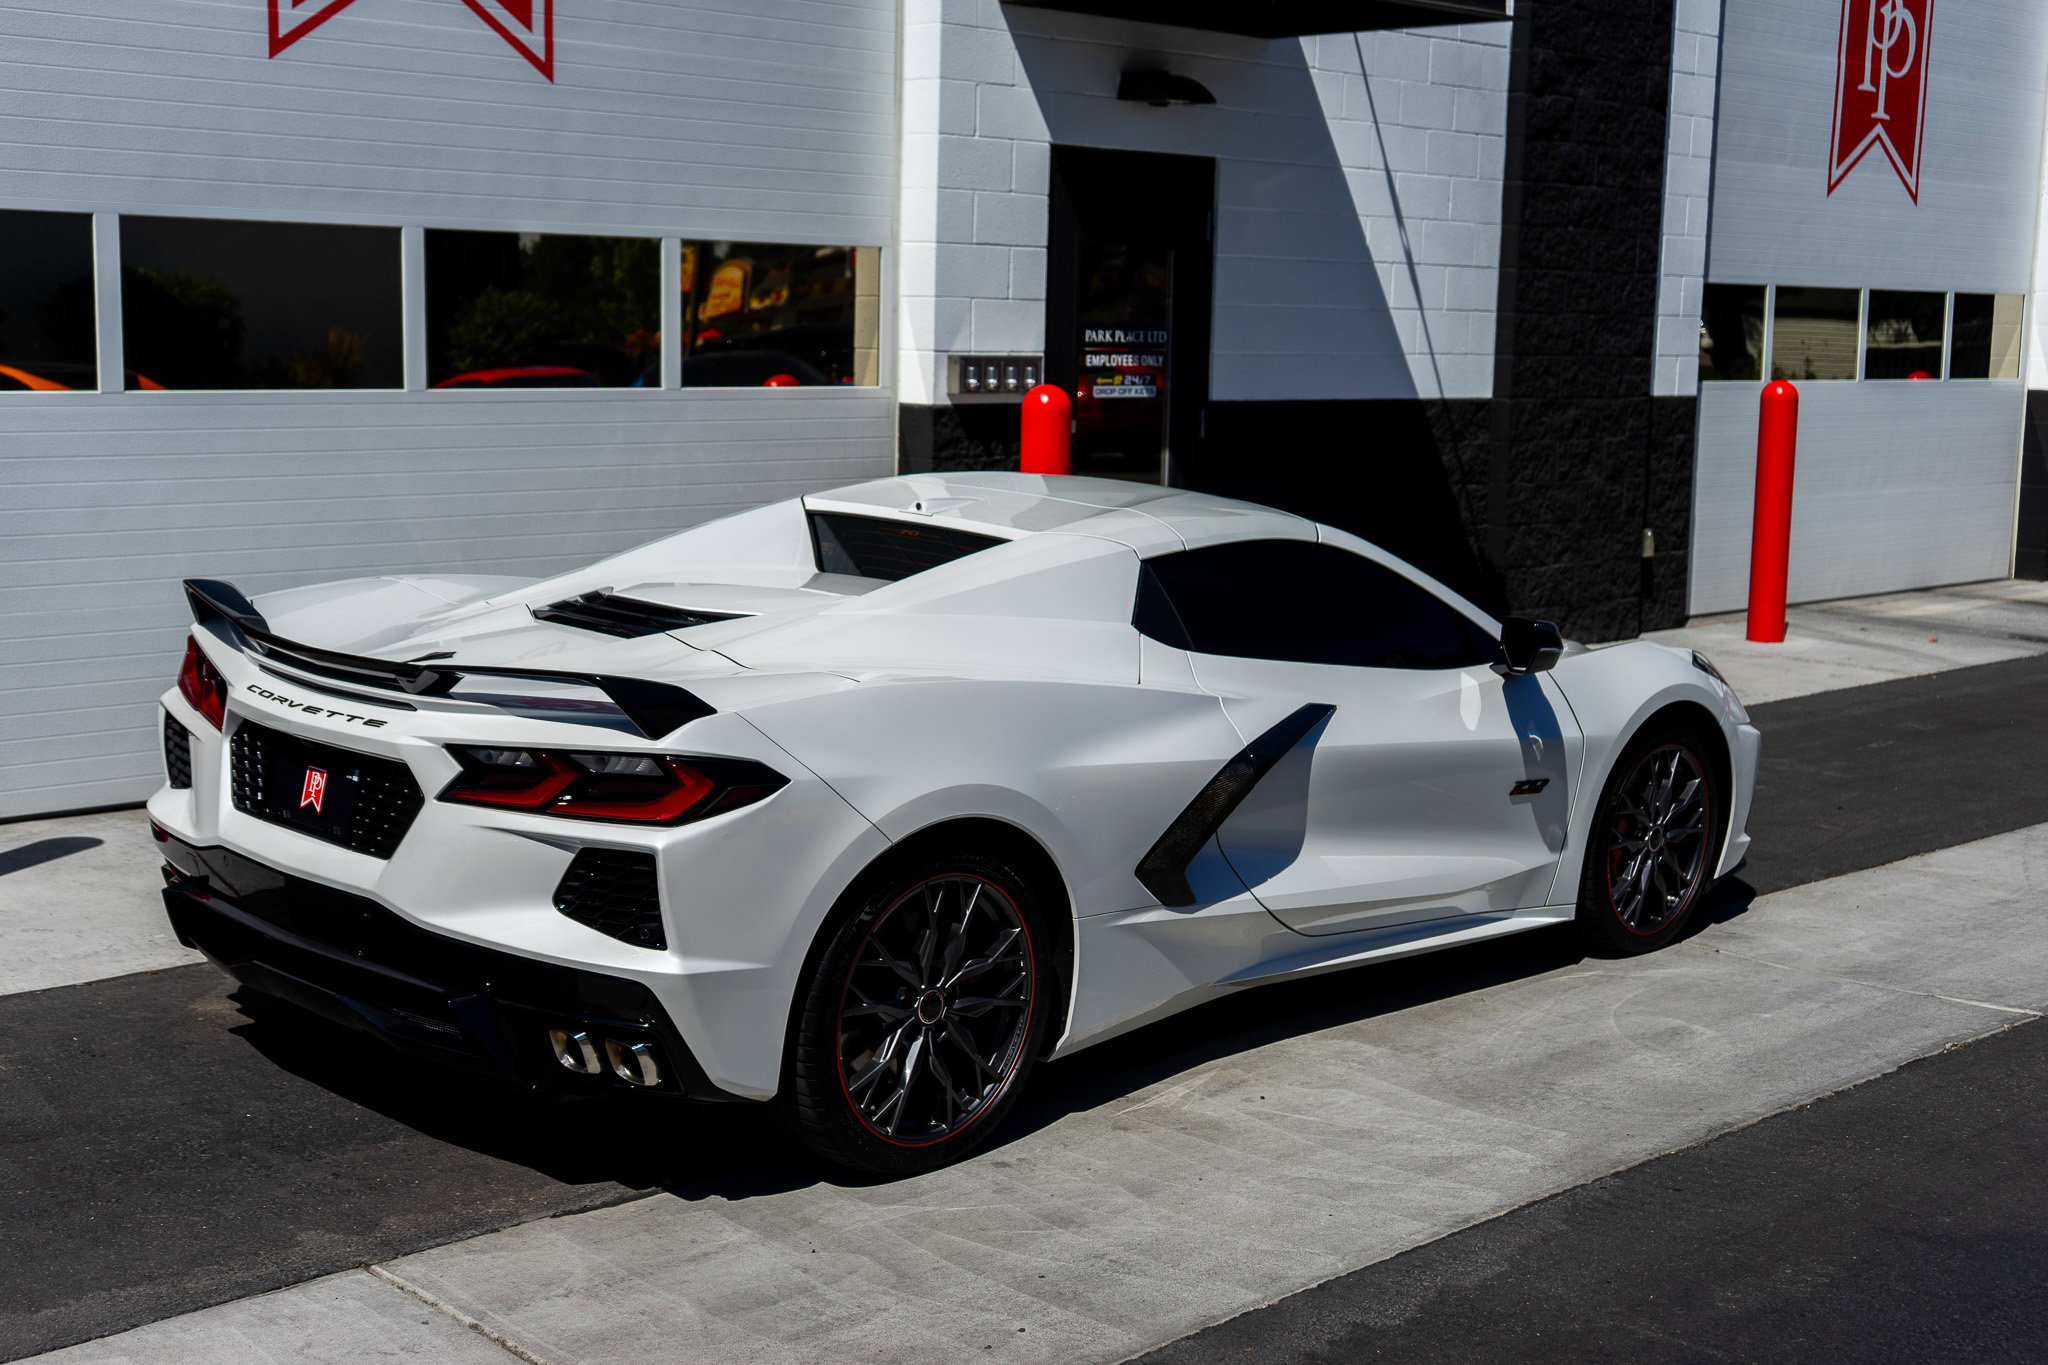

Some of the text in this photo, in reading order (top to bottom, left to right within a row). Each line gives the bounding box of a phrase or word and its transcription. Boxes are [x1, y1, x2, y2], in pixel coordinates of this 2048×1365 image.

[1085, 329, 1168, 343] PARK PLACE LTD
[1085, 354, 1164, 367] EMPLOYEES ONLY
[1123, 375, 1151, 385] 24/7
[1095, 387, 1116, 396] DROP
[246, 684, 389, 728] CORVETTE
